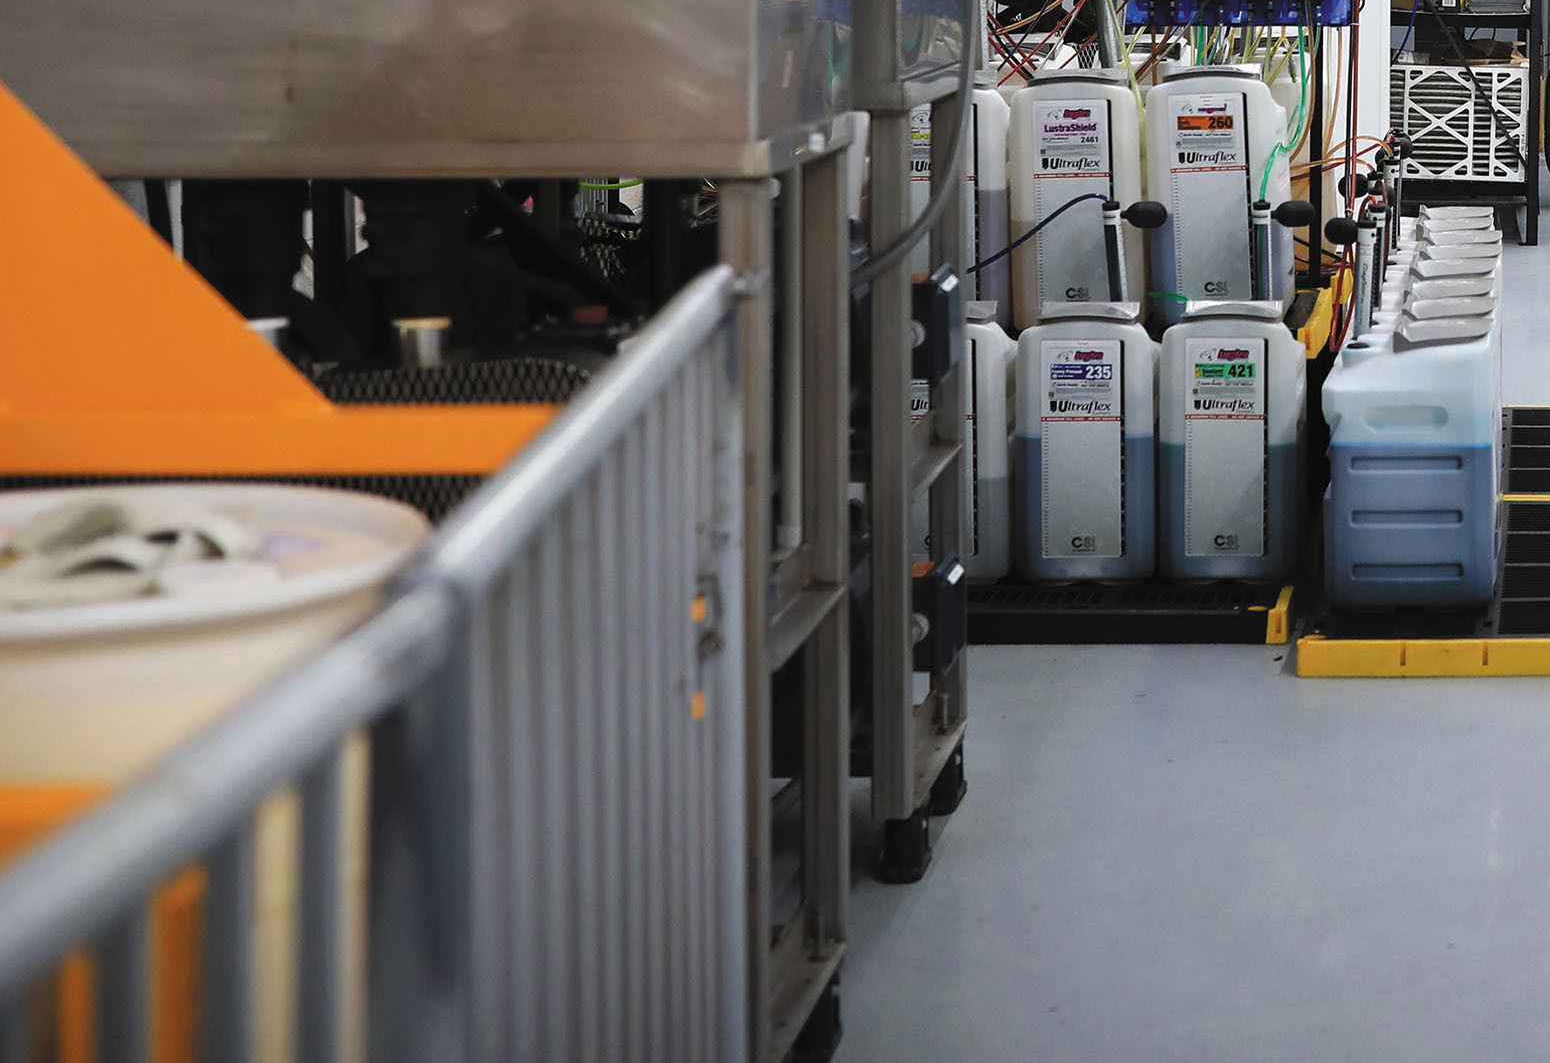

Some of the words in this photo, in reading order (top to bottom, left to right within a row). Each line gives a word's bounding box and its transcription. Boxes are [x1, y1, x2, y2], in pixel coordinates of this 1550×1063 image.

[1044, 122, 1097, 133] LustraShield
[1208, 117, 1233, 129] 260
[1050, 157, 1101, 170] Ultraflex
[1187, 151, 1236, 164] Ultraflex
[1085, 365, 1111, 379] 235
[1228, 364, 1254, 377] 421
[1058, 400, 1112, 413] Ultraflex
[1202, 399, 1255, 412] Ultraflex
